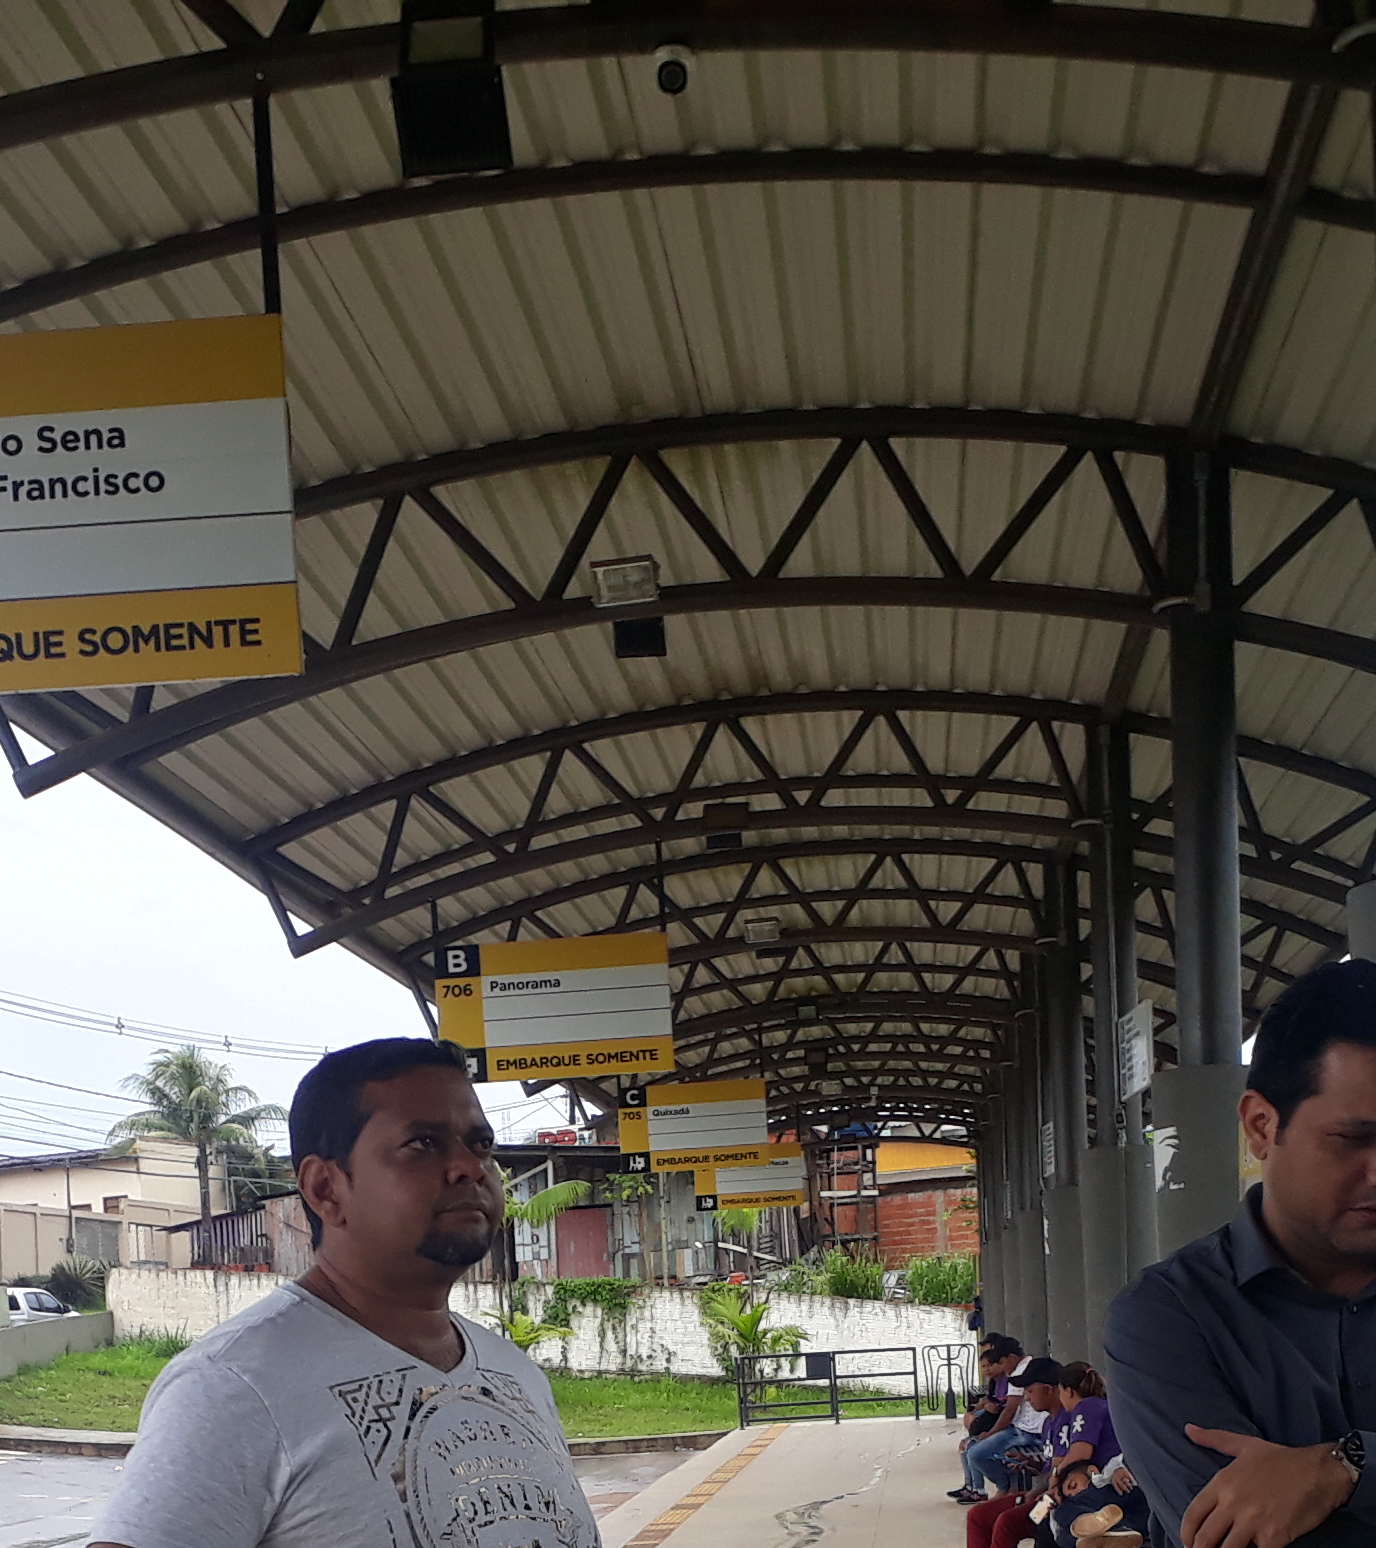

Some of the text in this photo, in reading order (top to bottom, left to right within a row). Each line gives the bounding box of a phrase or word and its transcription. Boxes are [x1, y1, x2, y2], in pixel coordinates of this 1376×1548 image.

[36, 422, 127, 454] Sena
[78, 617, 263, 657] SOMENTE
[446, 949, 469, 974] B
[441, 983, 474, 999] 706
[489, 977, 562, 993] Panorama
[496, 1048, 660, 1072] EMBARQUE SOMENTE
[625, 1089, 641, 1105] C
[656, 1155, 710, 1167] EMBARQUE
[713, 1151, 760, 1163] SOMENTE
